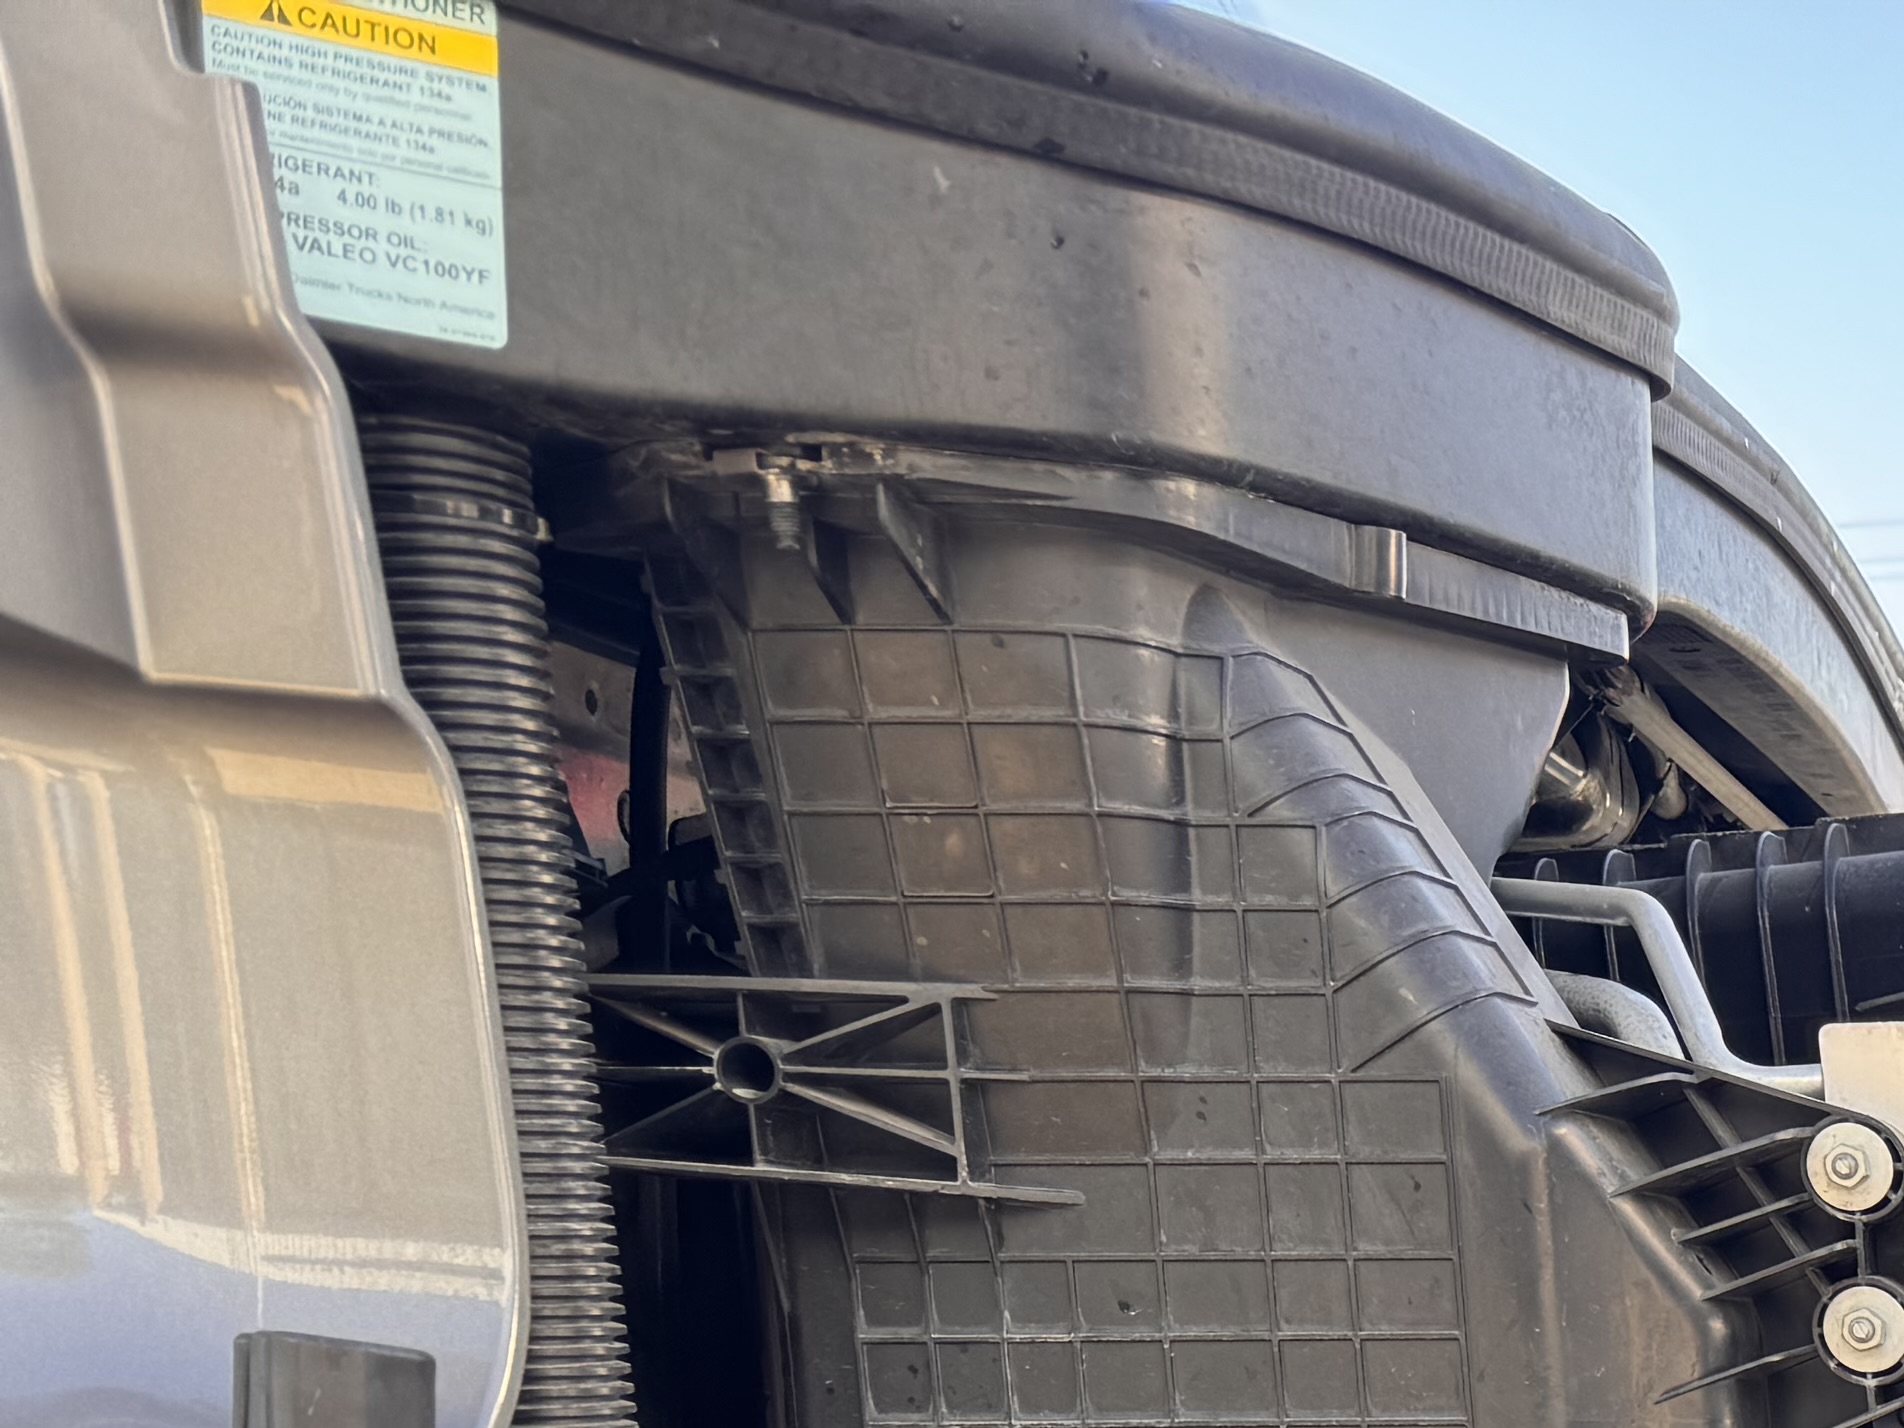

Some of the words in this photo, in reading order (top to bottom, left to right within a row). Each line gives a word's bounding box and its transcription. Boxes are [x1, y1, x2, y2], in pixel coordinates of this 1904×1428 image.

[210, 24, 283, 51] CAUTION
[289, 40, 328, 59] HIGH
[332, 50, 420, 79] PRESSURE
[297, 7, 438, 55] CAUTION
[211, 41, 293, 70] CONTAINS
[299, 60, 413, 95] REFRIGERANT
[418, 86, 454, 103] 134a
[315, 81, 341, 98] only
[343, 86, 359, 102] by
[291, 113, 401, 148] REFRIGERANTE
[312, 101, 374, 126] SISTEMA
[378, 115, 389, 130] A
[390, 118, 424, 137] ALTA
[337, 188, 377, 211] 4.00
[384, 196, 402, 215] lb
[409, 200, 456, 225] (1.81
[463, 211, 494, 238] kg)
[292, 232, 377, 265] VALEO
[385, 250, 492, 287] VC100YF
[346, 281, 394, 303] Trucks
[397, 290, 436, 311] North
[439, 299, 497, 321] America
